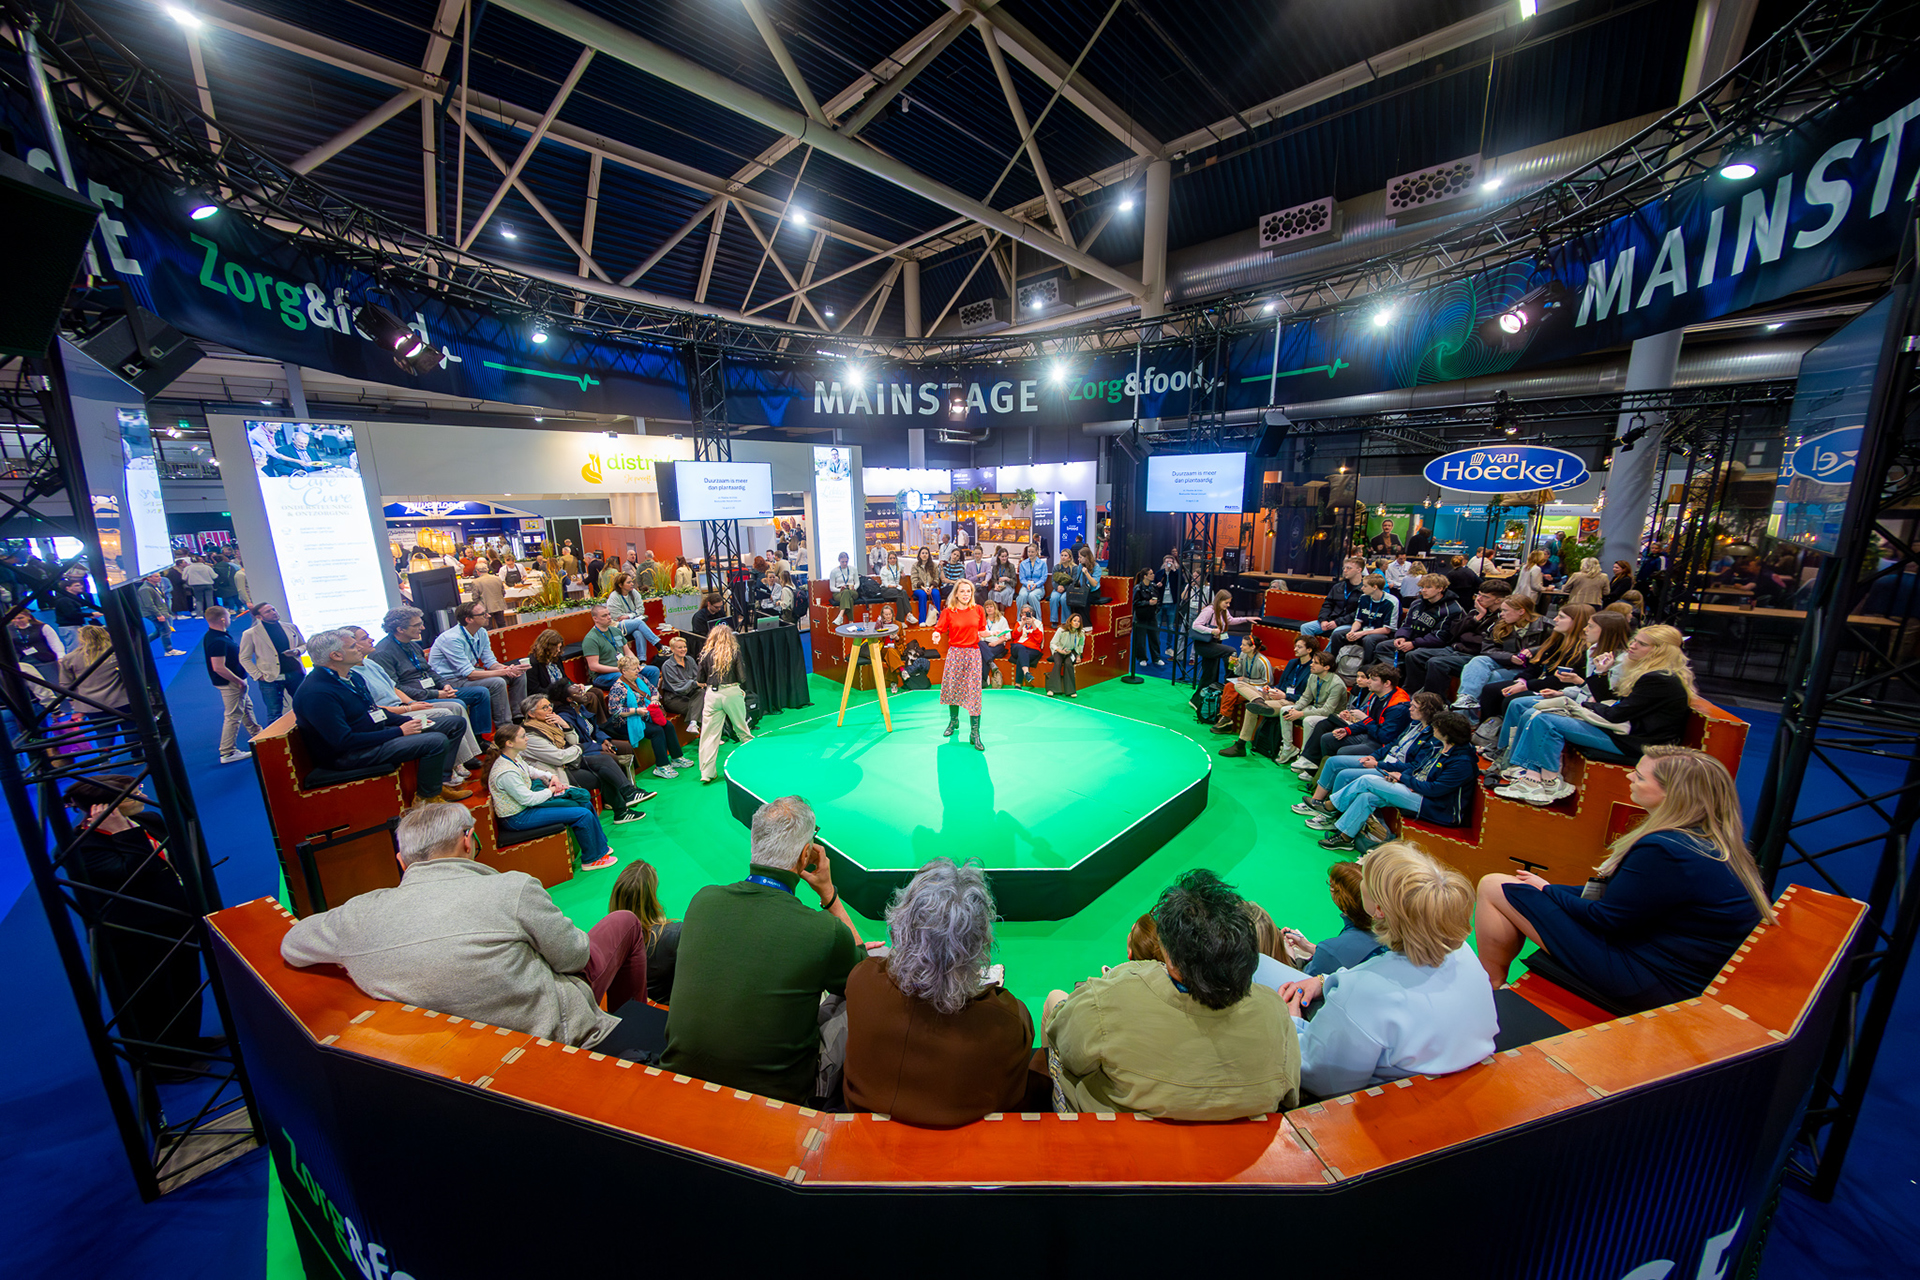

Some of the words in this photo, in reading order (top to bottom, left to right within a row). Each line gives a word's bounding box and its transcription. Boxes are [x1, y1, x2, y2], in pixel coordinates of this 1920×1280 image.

[1575, 98, 1920, 328] MAINST
[1487, 453, 1519, 463] van
[1441, 459, 1564, 485] Hoeckel
[718, 484, 746, 492] plantaardig
[668, 604, 698, 614] distrivers
